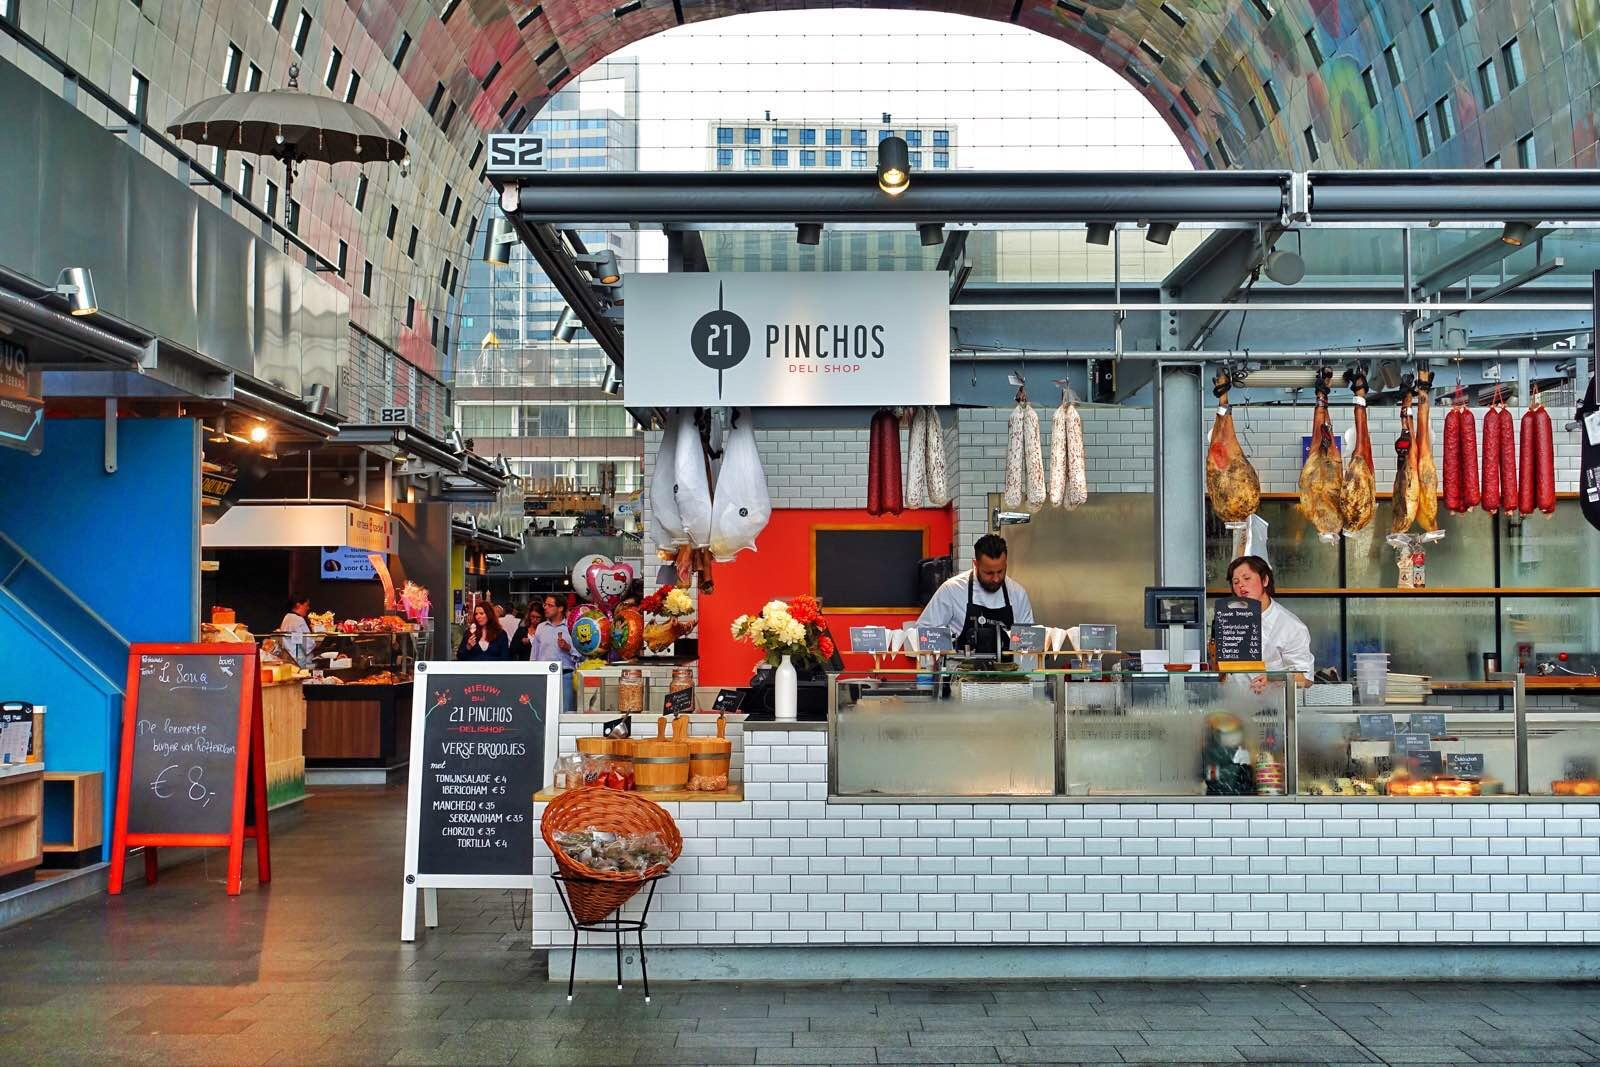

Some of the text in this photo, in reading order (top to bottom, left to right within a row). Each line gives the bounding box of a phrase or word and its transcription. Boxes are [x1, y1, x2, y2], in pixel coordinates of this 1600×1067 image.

[707, 324, 885, 359] 21 PINCHOS
[789, 364, 861, 373] DELI SHOP
[382, 409, 405, 421] 82
[450, 706, 513, 722] 21 PINCHOS
[442, 742, 526, 759] VERSE BROODJES
[430, 760, 446, 769] met
[150, 765, 178, 798] €
[436, 774, 491, 783] TONIJNSALADE
[442, 785, 488, 794] IBERICOHAM
[433, 801, 476, 810] MANCHEGO
[448, 814, 502, 823] SERRANOHAM
[442, 827, 475, 836] CHORIZO
[457, 839, 491, 848] TORTILLA
